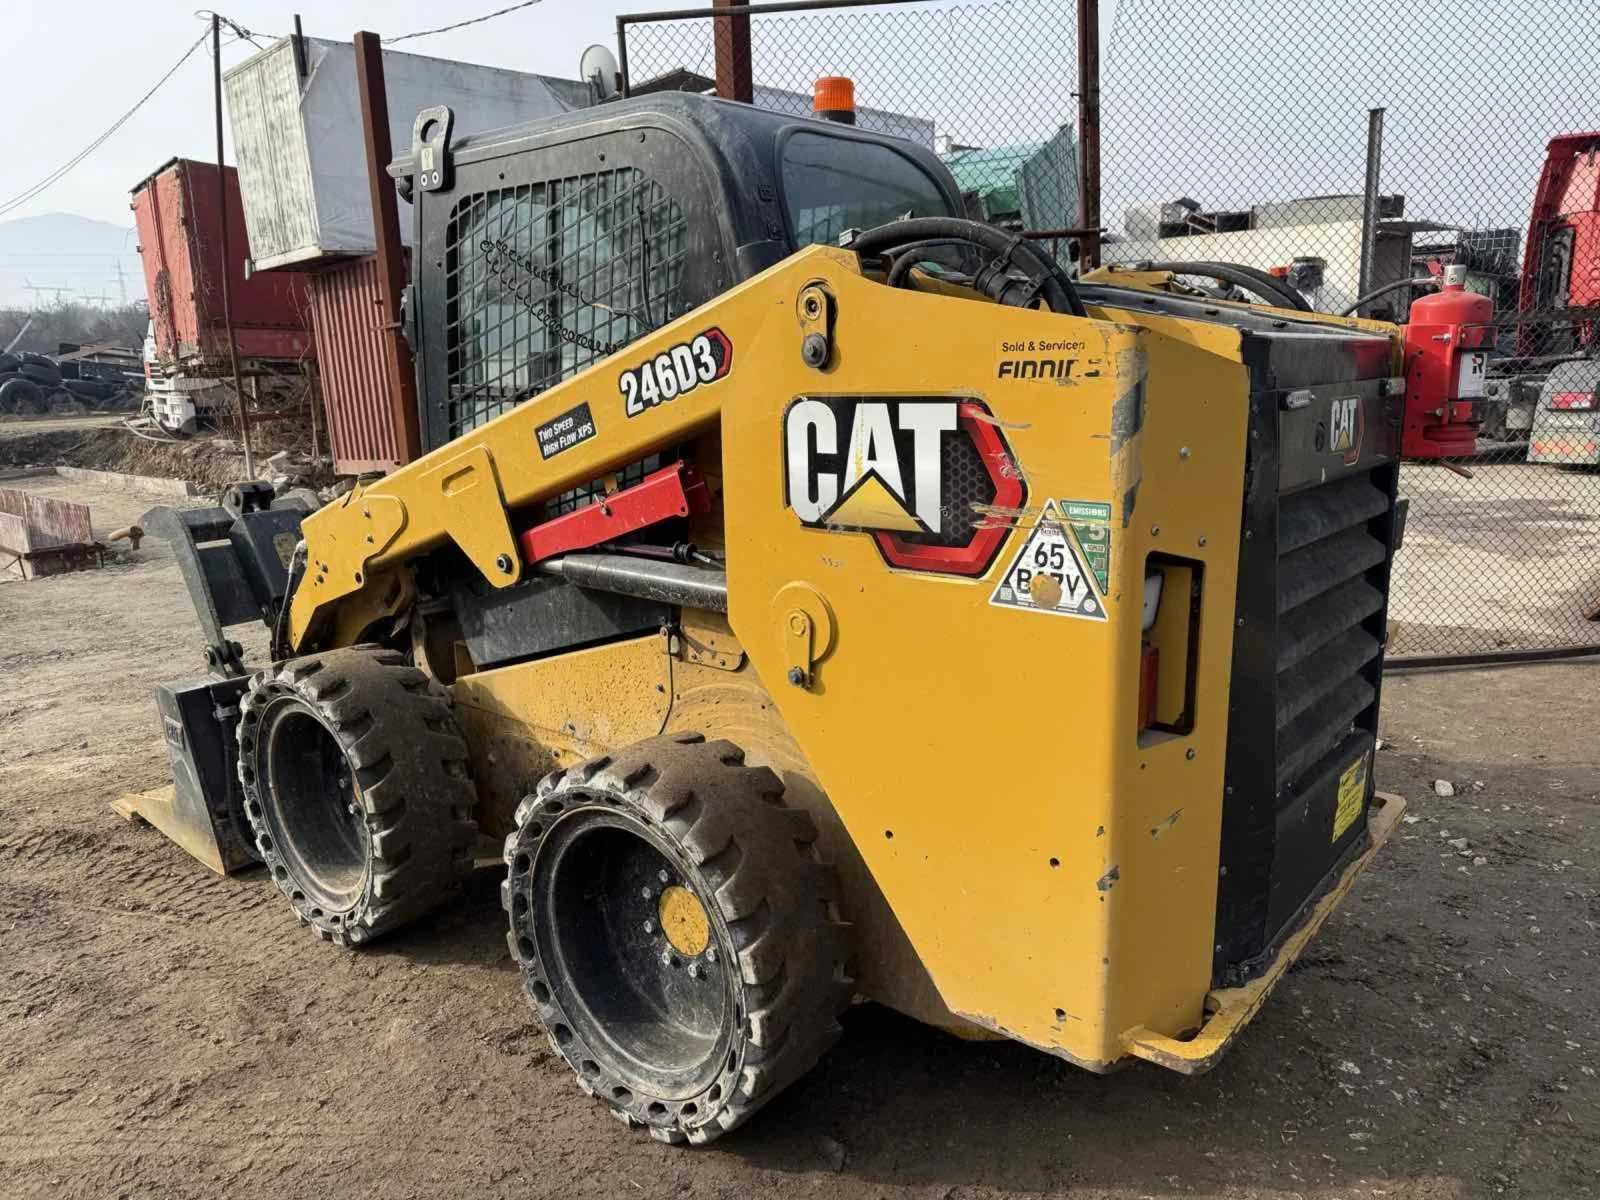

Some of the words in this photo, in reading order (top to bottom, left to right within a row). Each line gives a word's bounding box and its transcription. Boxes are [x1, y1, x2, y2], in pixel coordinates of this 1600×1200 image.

[1002, 342, 1025, 352] Sold
[1027, 341, 1035, 351] &
[619, 335, 718, 417] 246D3
[577, 422, 593, 439] XPS
[1330, 399, 1357, 451] CAT
[787, 400, 958, 534] CAT
[1034, 542, 1065, 570] 65
